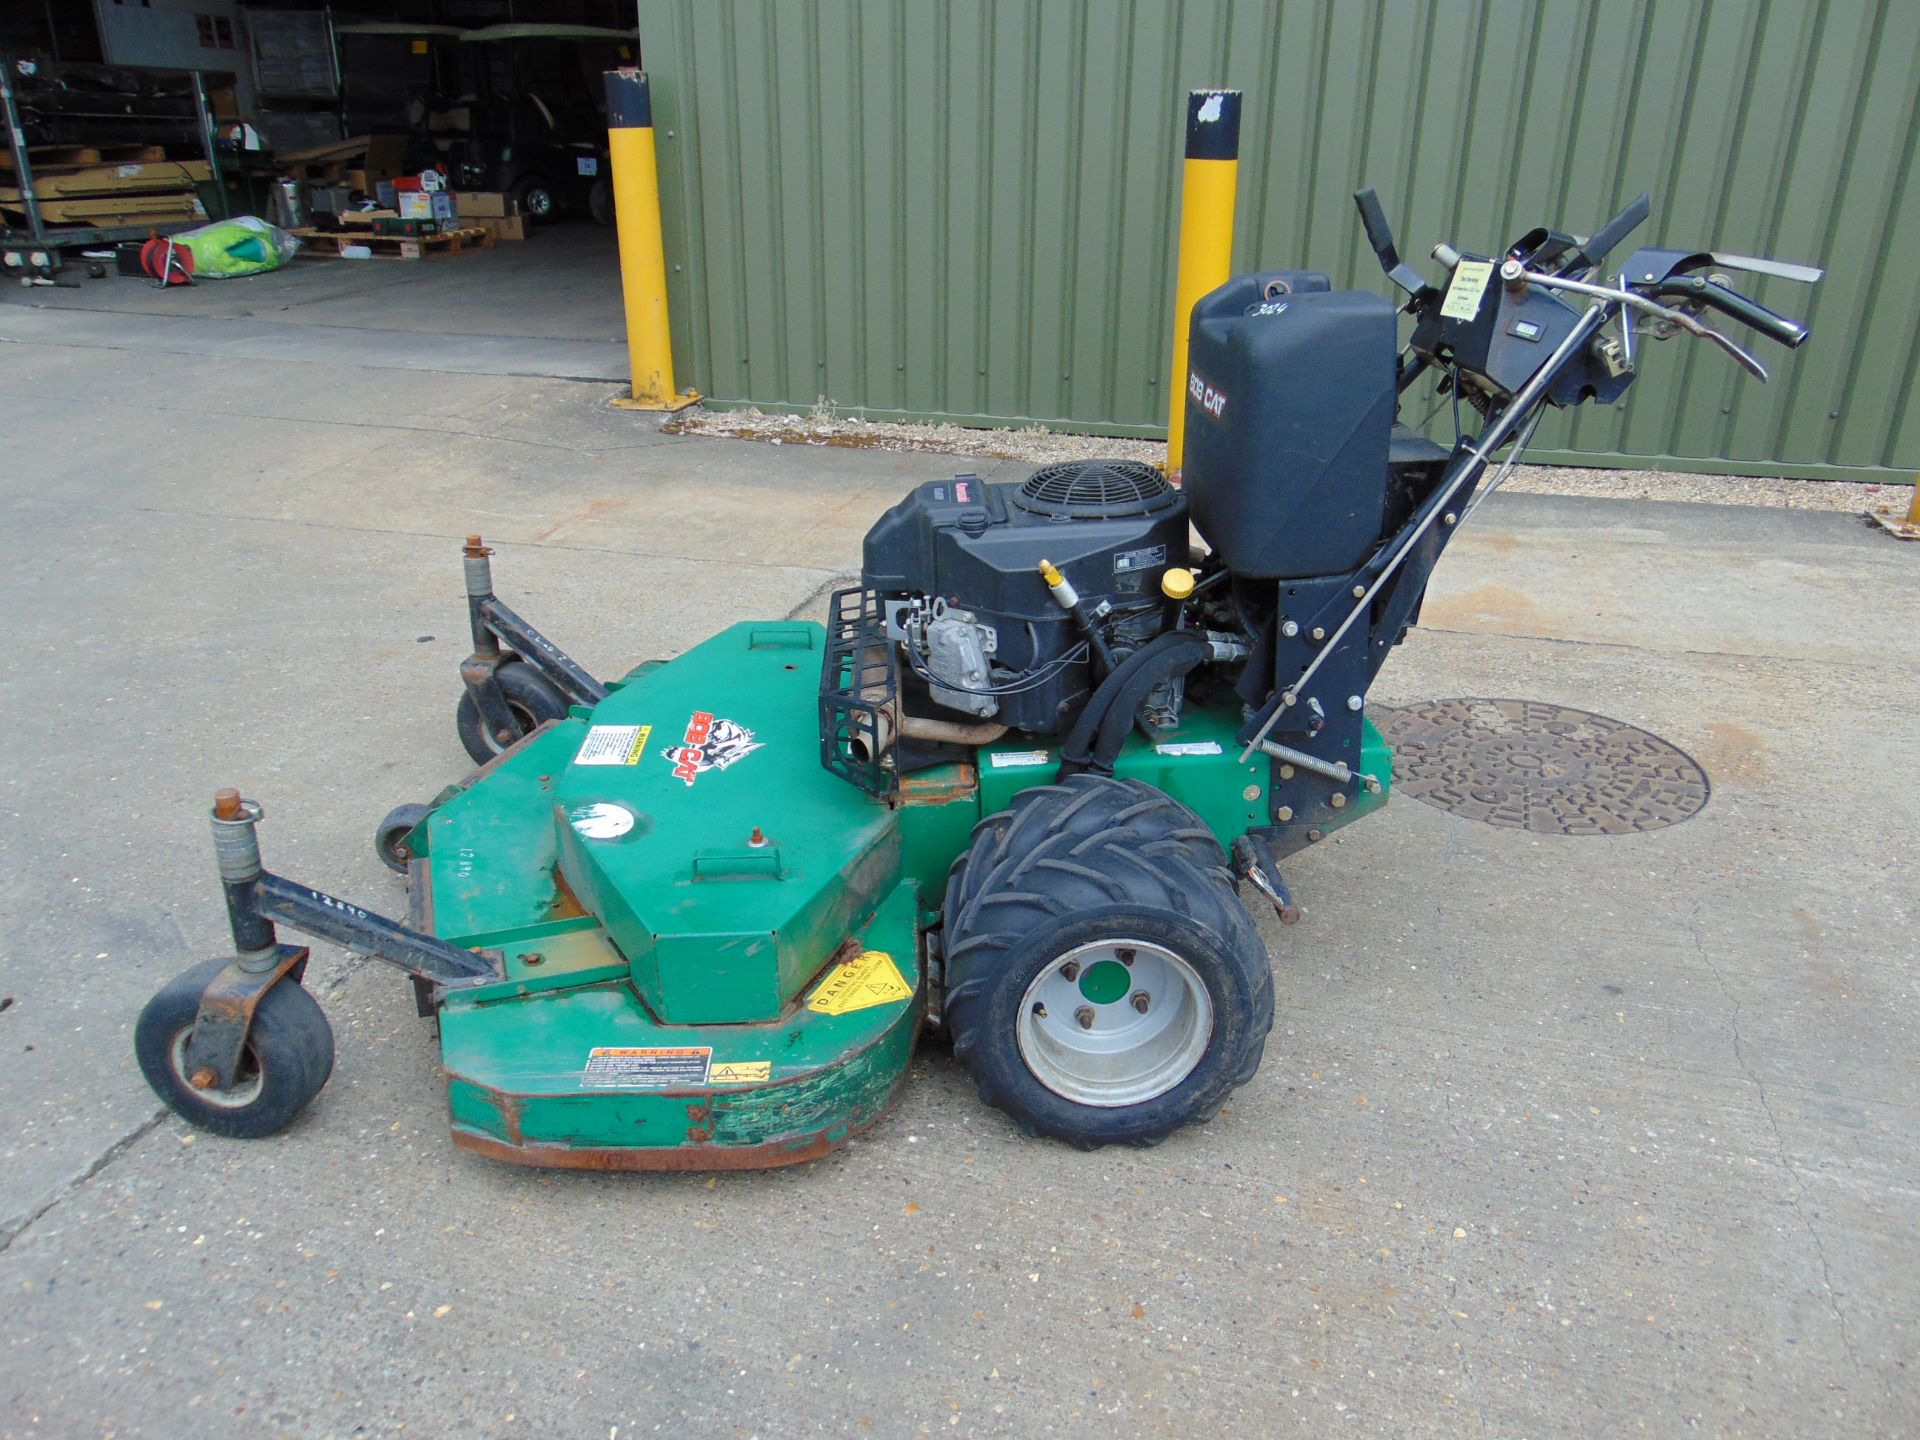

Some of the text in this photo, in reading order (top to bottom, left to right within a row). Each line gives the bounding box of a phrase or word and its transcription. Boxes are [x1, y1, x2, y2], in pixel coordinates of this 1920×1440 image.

[1189, 372, 1226, 416] BOB CAT
[673, 710, 713, 782] BOB CAT
[816, 954, 870, 1006] DANGER
